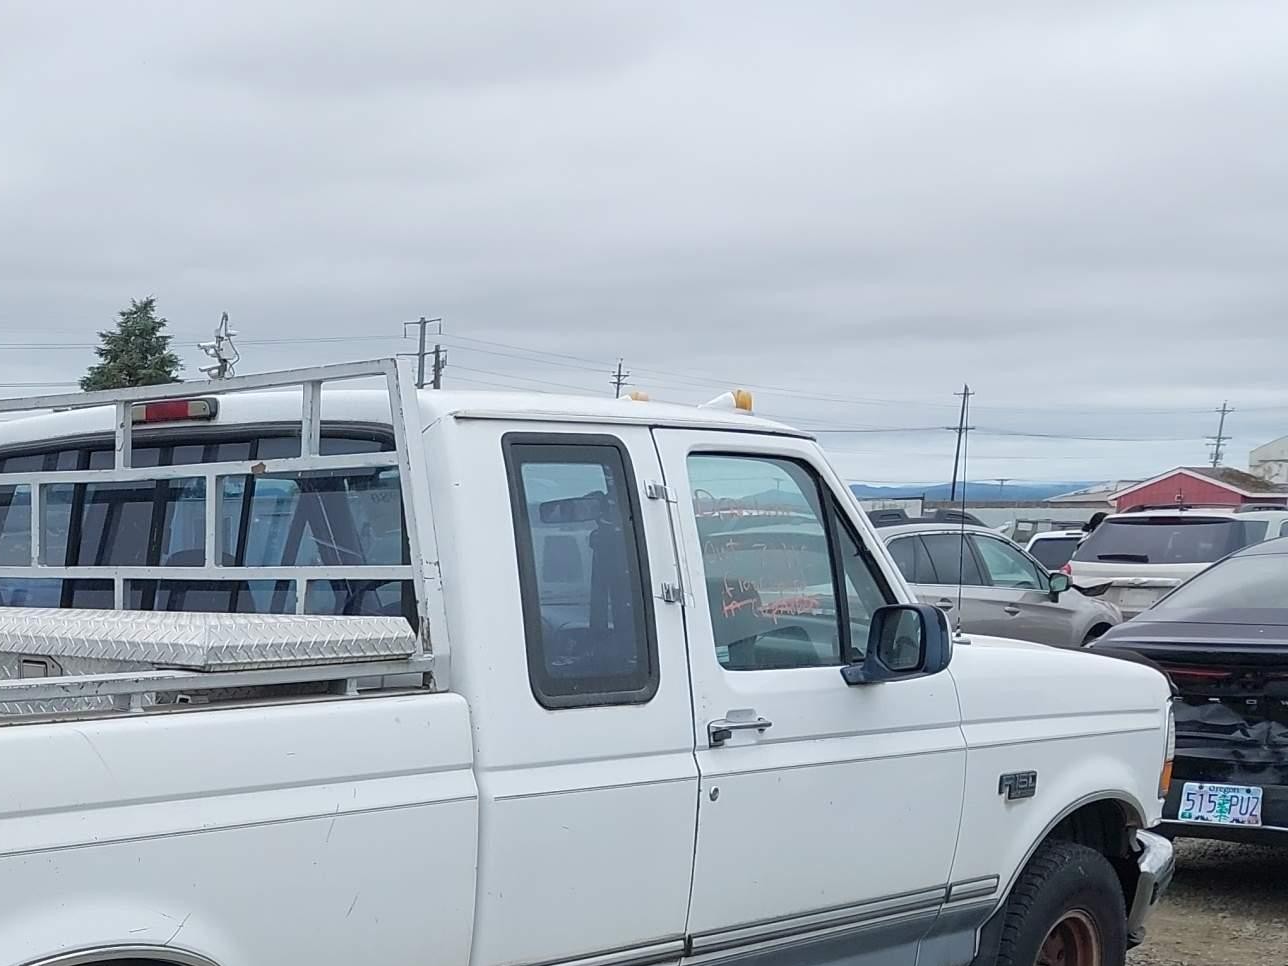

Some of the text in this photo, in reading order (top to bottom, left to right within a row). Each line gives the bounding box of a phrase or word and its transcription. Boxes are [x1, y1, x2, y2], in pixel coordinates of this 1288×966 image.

[1209, 785, 1240, 794] Oregon
[1184, 792, 1260, 817] 515 PUZ
